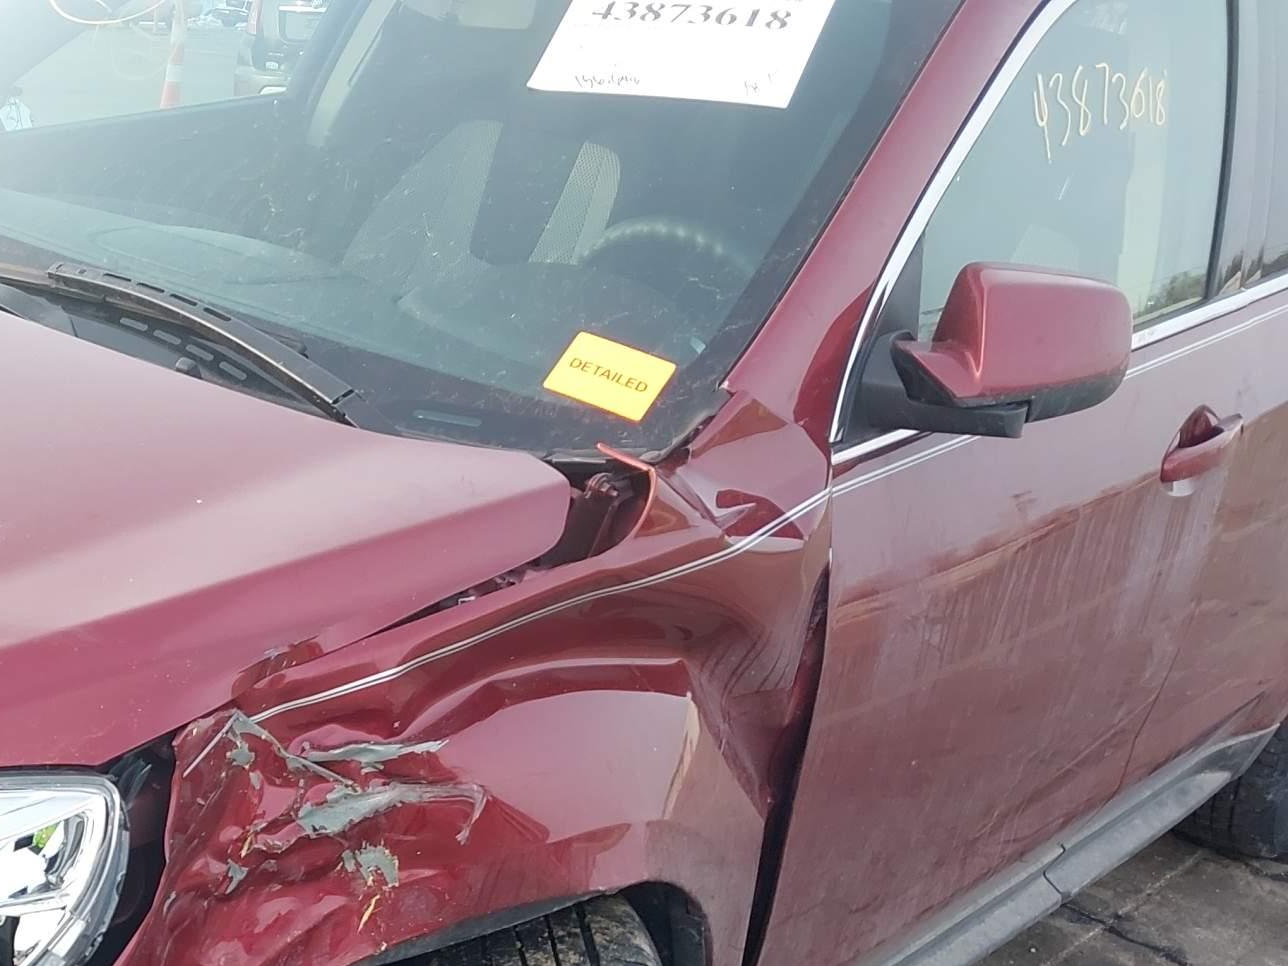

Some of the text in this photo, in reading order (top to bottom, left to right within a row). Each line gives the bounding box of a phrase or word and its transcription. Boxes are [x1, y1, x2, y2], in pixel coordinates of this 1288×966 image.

[591, 1, 792, 29] 43873618
[1034, 62, 1168, 164] 43873618
[569, 357, 648, 393] DETAILED
